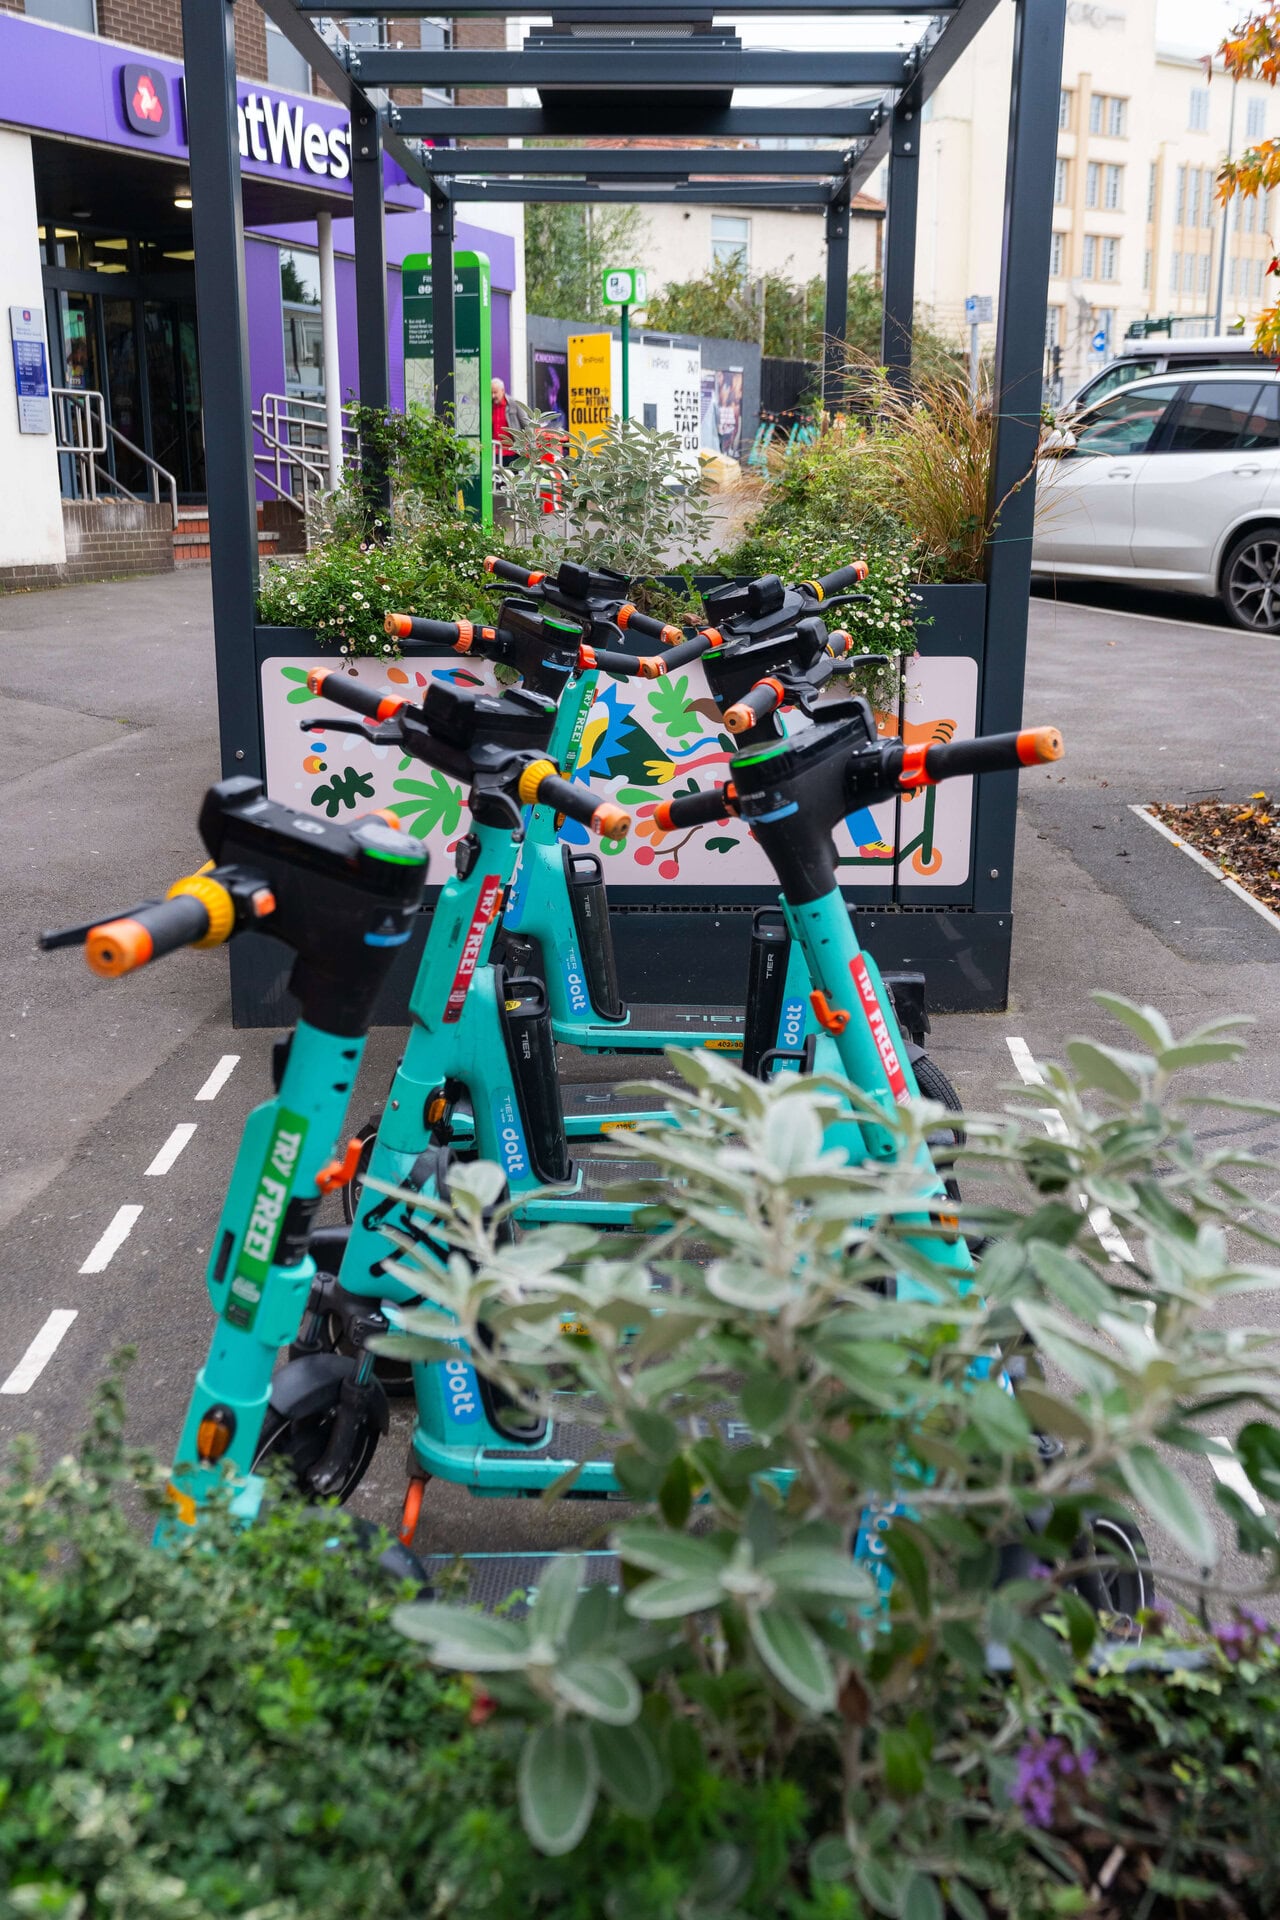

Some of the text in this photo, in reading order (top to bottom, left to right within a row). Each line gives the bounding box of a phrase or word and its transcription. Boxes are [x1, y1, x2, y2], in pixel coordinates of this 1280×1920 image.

[571, 387, 600, 396] SEND
[571, 407, 609, 424] COLLECT
[674, 414, 698, 432] TAP
[583, 688, 594, 706] TRY
[571, 709, 588, 742] FREE!
[584, 894, 592, 918] TIER
[458, 887, 498, 975] TRY FREE!
[569, 947, 577, 970] TIER
[766, 953, 774, 980] TIER
[568, 973, 586, 1010] dott
[783, 1004, 802, 1046] dott
[858, 967, 900, 1077] TRY FREE!
[520, 1030, 531, 1060] TIER
[504, 1095, 514, 1123] TIER
[271, 1130, 302, 1178] TRY
[502, 1128, 525, 1173] dott
[242, 1176, 287, 1262] FREE!
[446, 1358, 475, 1416] dott
